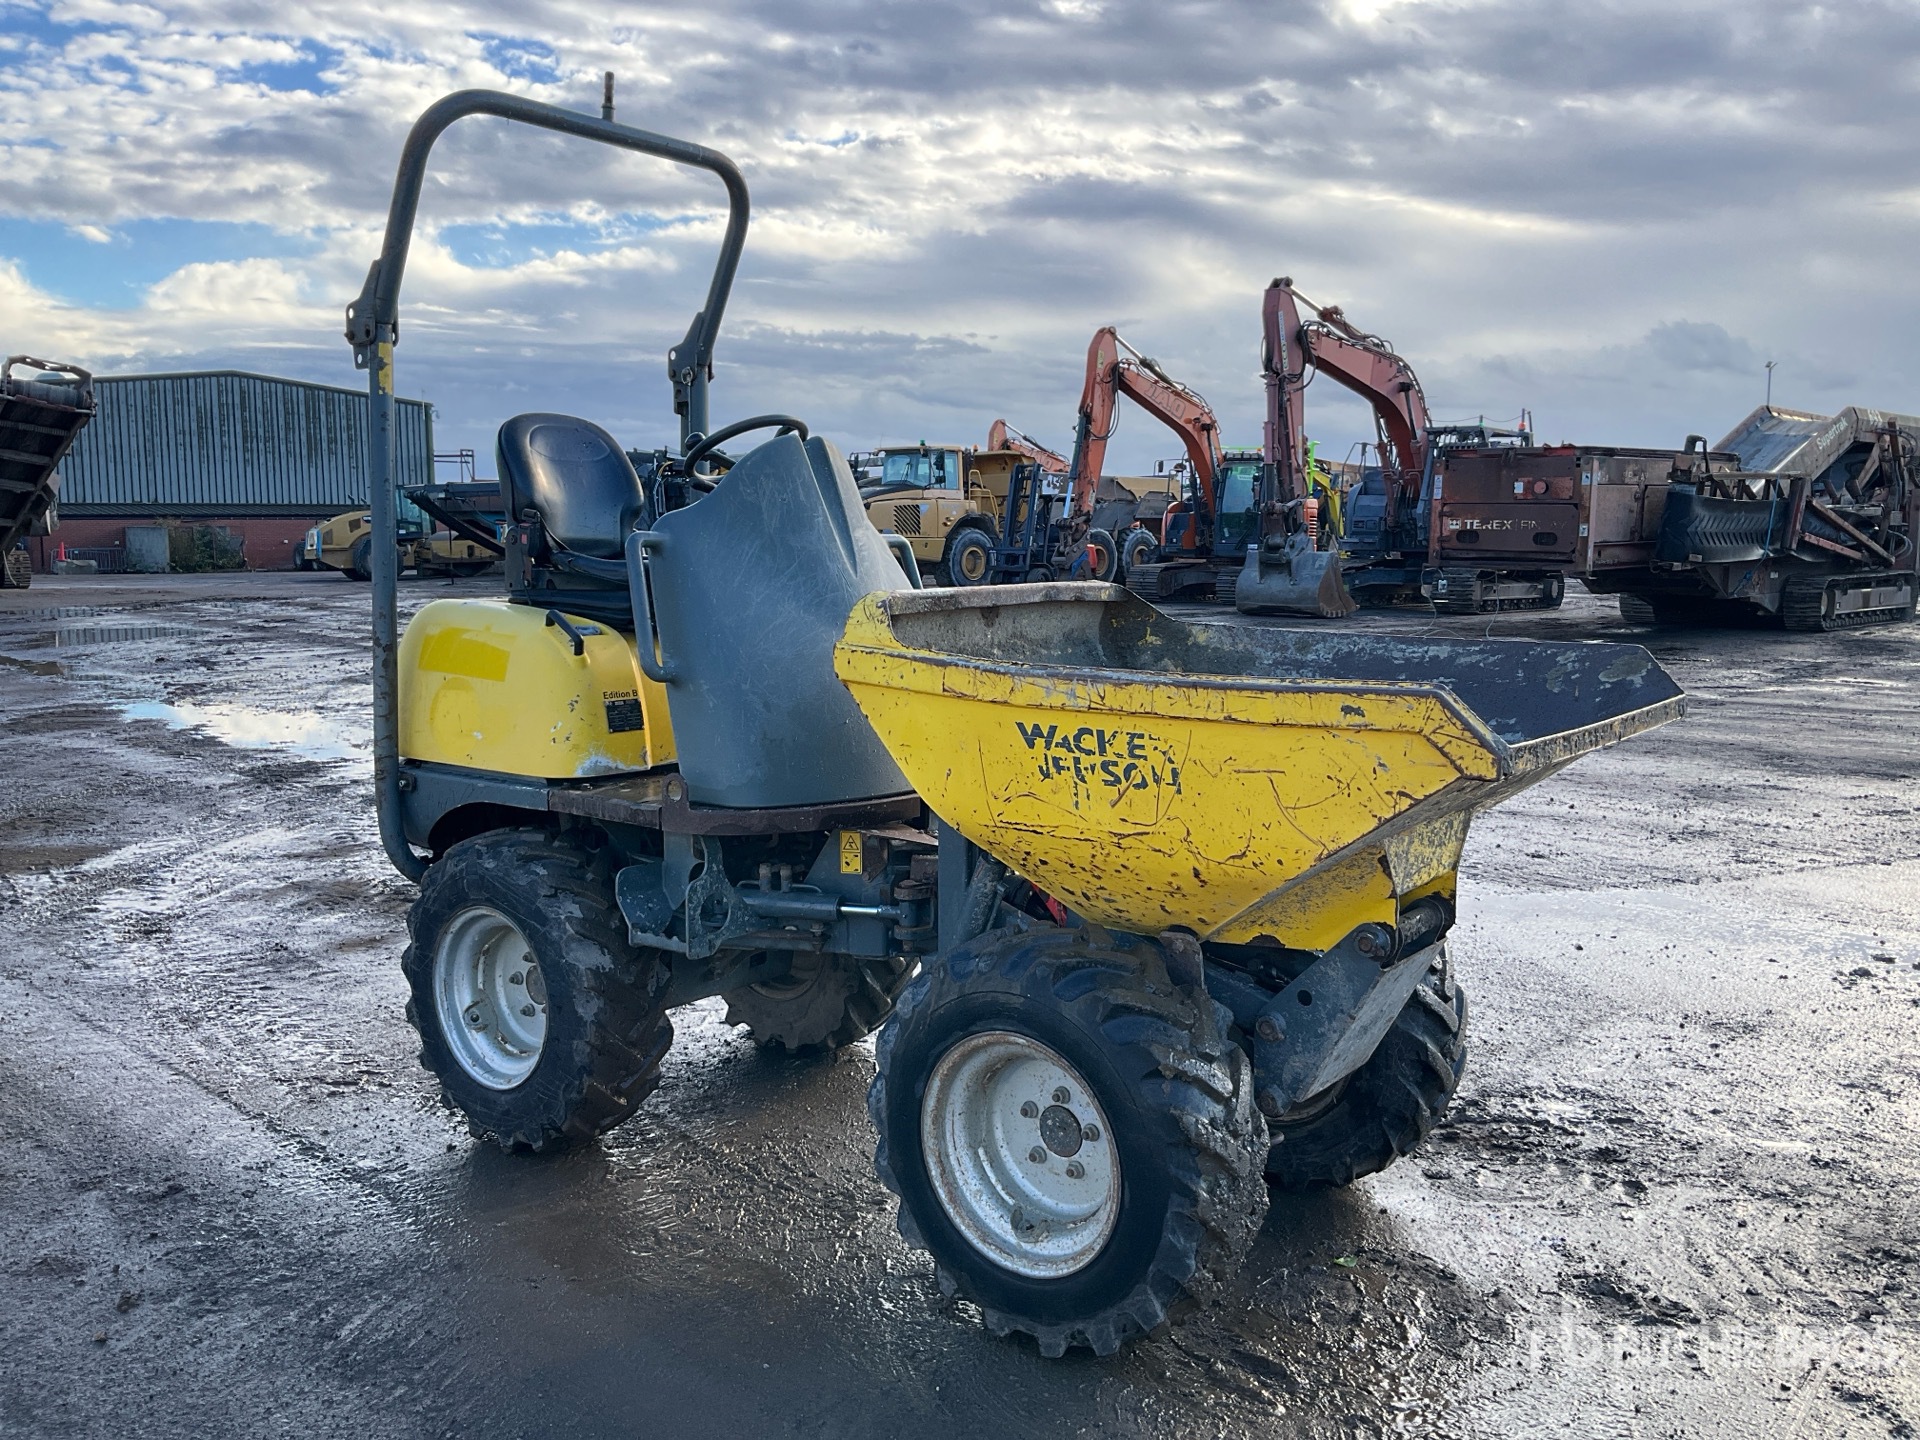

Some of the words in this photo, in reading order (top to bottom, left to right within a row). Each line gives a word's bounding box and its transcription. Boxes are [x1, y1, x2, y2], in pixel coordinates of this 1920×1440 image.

[1816, 416, 1849, 450] Supertrak
[1464, 519, 1513, 530] TEREX
[603, 691, 630, 699] Edition
[632, 689, 638, 697] B
